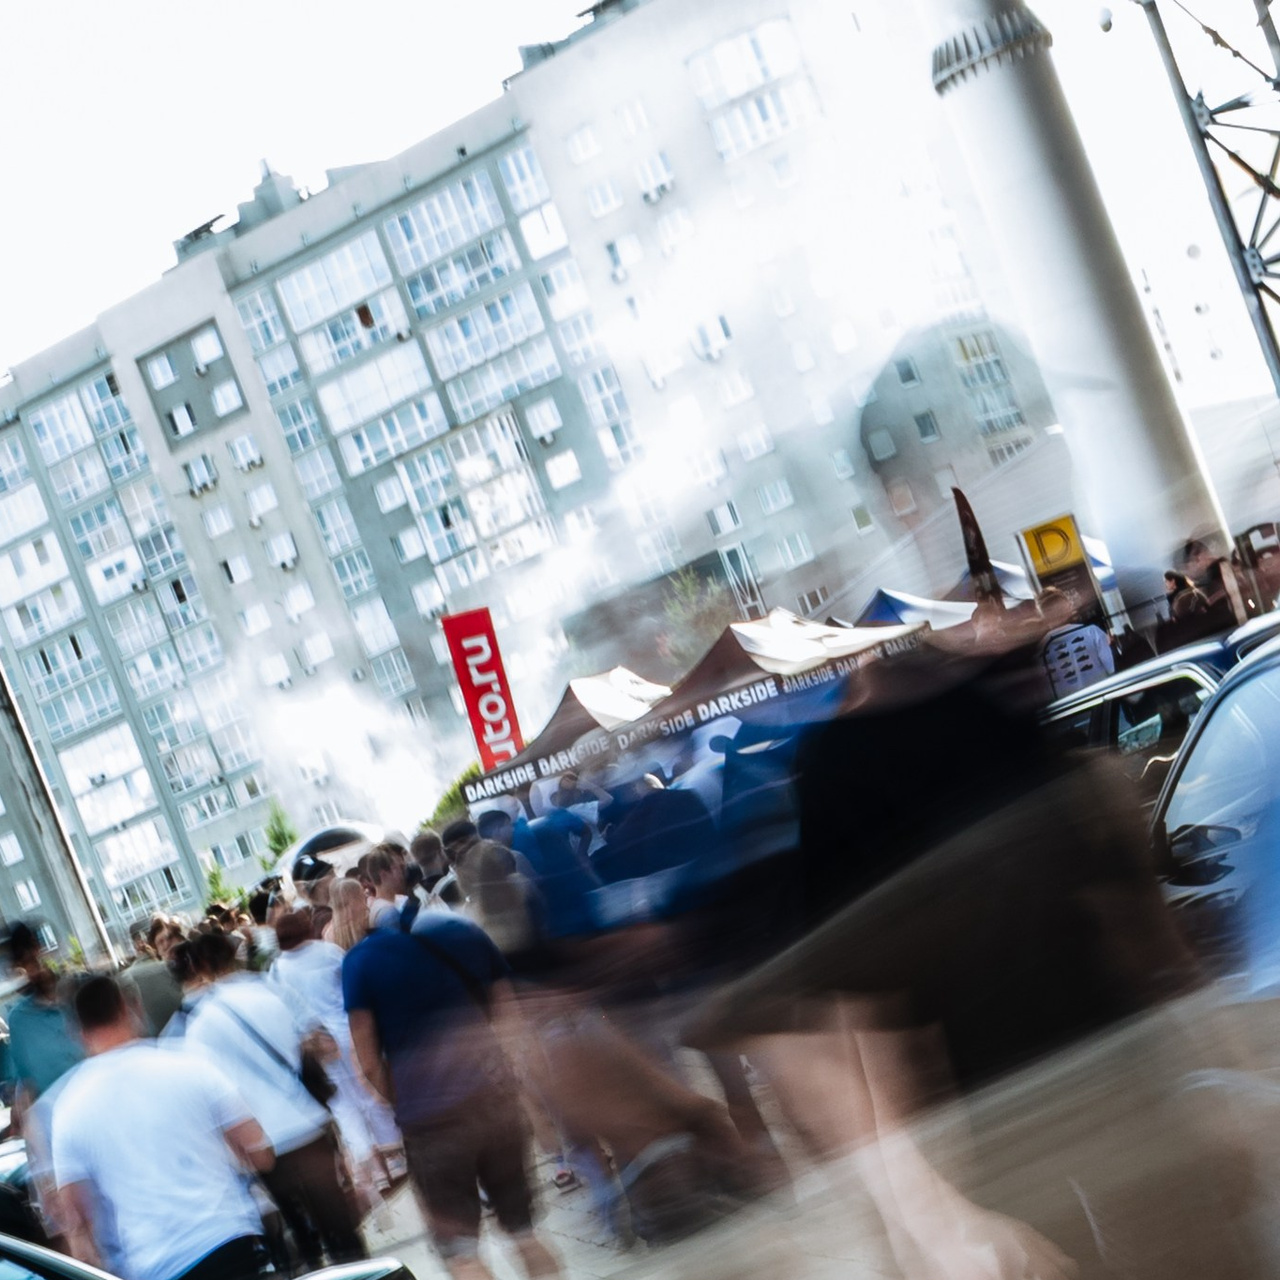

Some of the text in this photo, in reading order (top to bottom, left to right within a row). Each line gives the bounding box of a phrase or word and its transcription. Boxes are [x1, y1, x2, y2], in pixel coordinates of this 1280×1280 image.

[1031, 525, 1073, 569] D
[461, 633, 518, 769] uto.ru
[782, 665, 836, 694] DARKSIDE
[465, 678, 778, 802] DARKSIDE DARKSIDE DARKSIDE DARKSIDE
